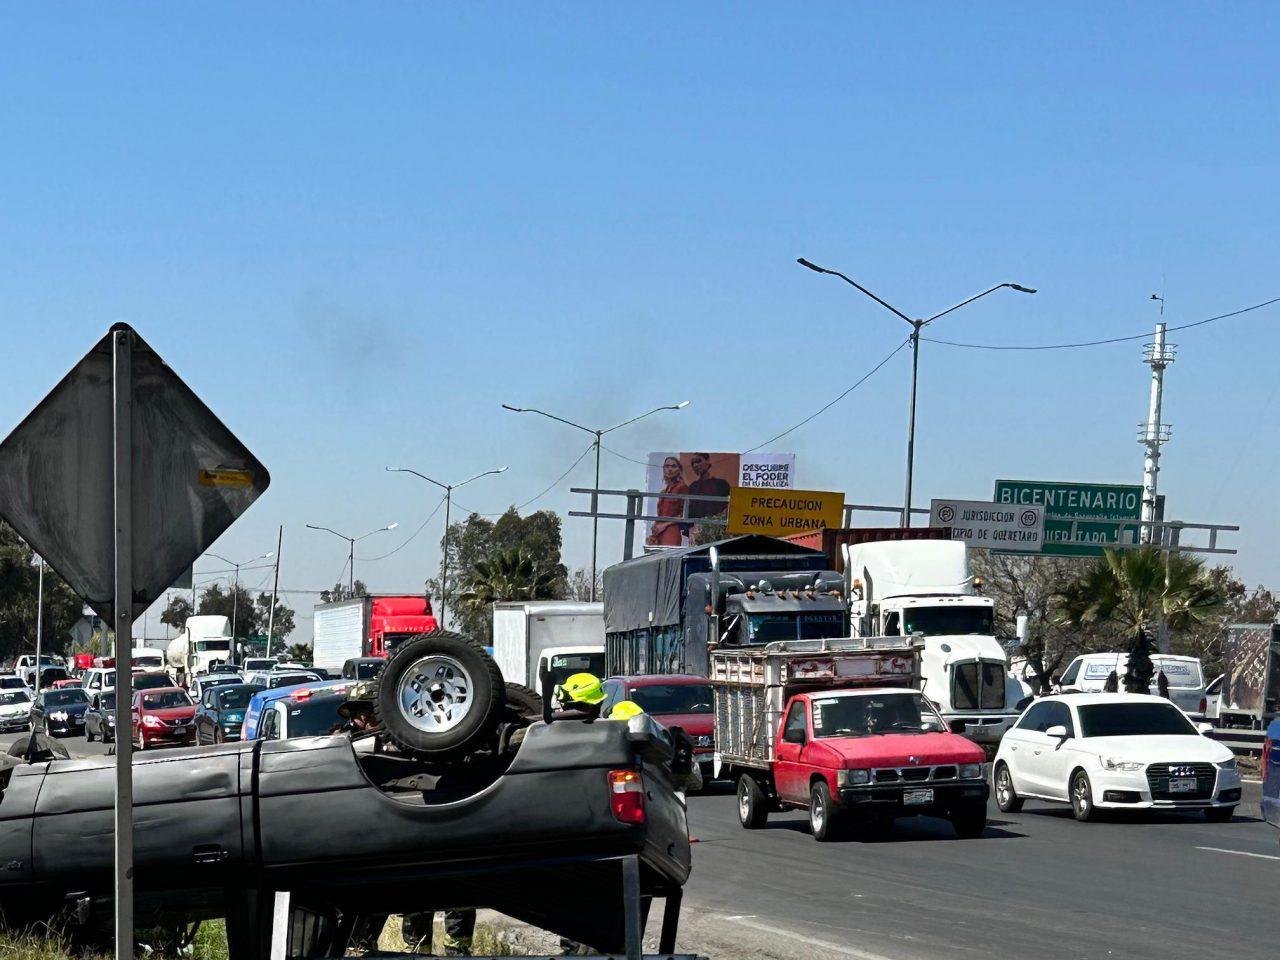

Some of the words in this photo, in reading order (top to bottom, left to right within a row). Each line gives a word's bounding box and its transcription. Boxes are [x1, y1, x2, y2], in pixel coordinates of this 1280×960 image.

[742, 472, 754, 481] EL
[751, 497, 823, 511] PRECAUCION
[1001, 487, 1137, 510] BICENTENARIO
[742, 514, 774, 527] ZONA
[780, 517, 827, 529] URBANA
[978, 529, 988, 539] DE
